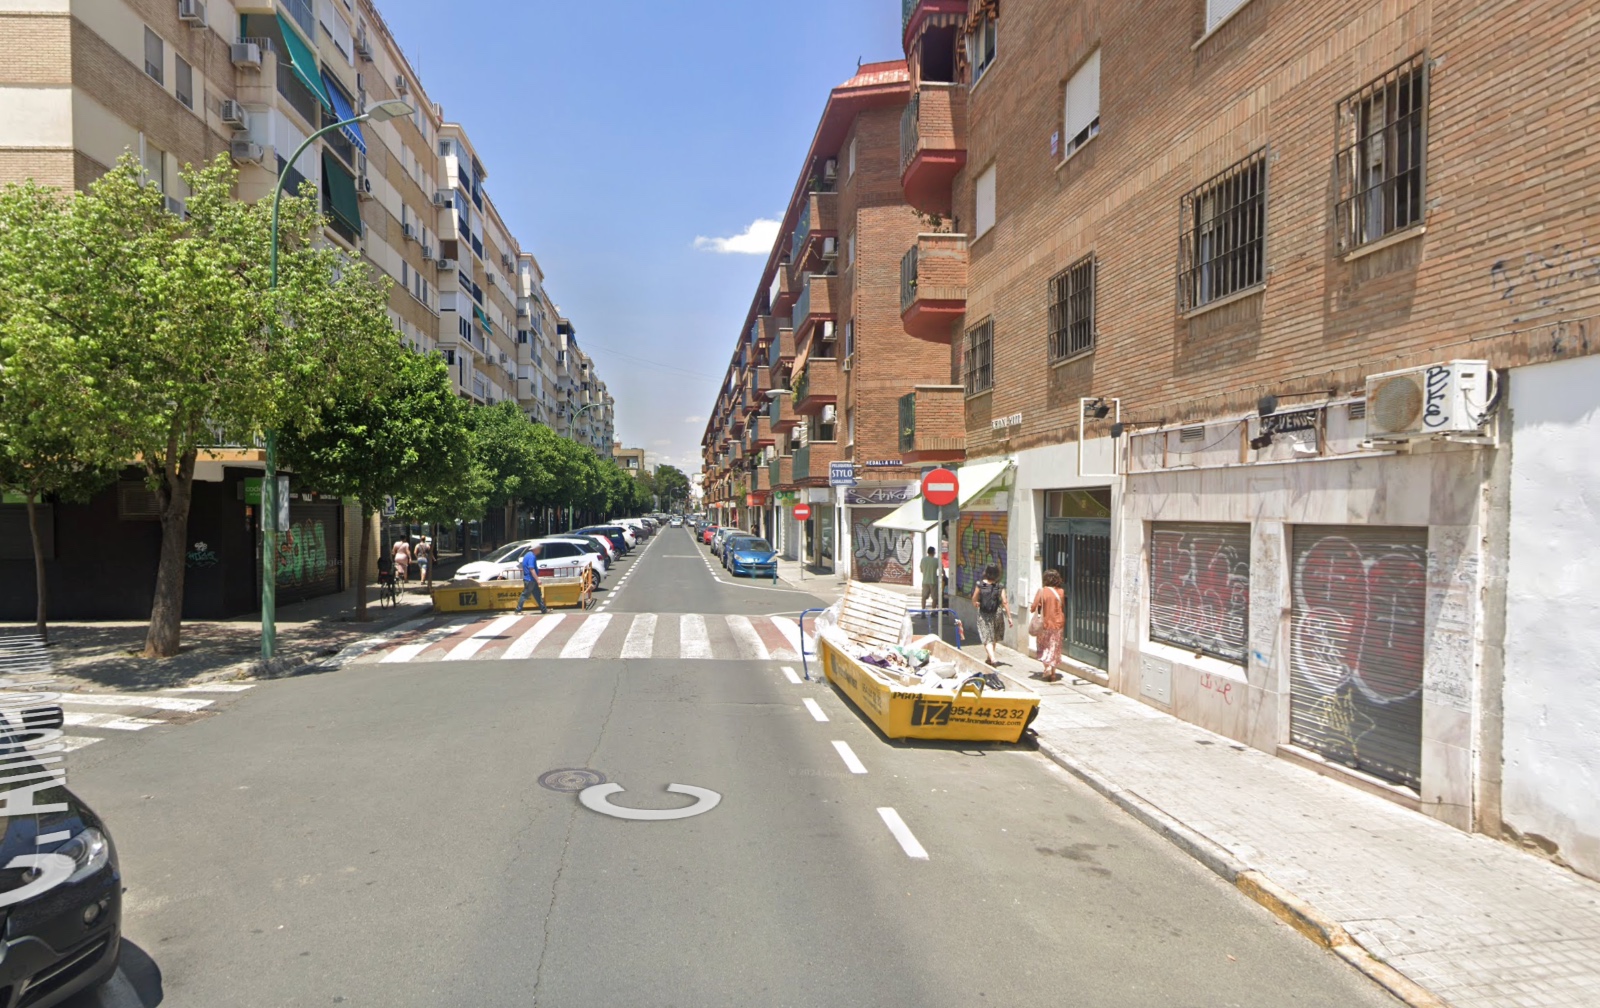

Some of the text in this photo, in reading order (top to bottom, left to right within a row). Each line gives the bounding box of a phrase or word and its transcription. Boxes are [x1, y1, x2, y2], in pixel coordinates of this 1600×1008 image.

[832, 469, 853, 477] STYLO
[951, 706, 973, 716] 954
[975, 707, 991, 717] 44
[993, 708, 1008, 718] 32
[1009, 709, 1024, 719] 32
